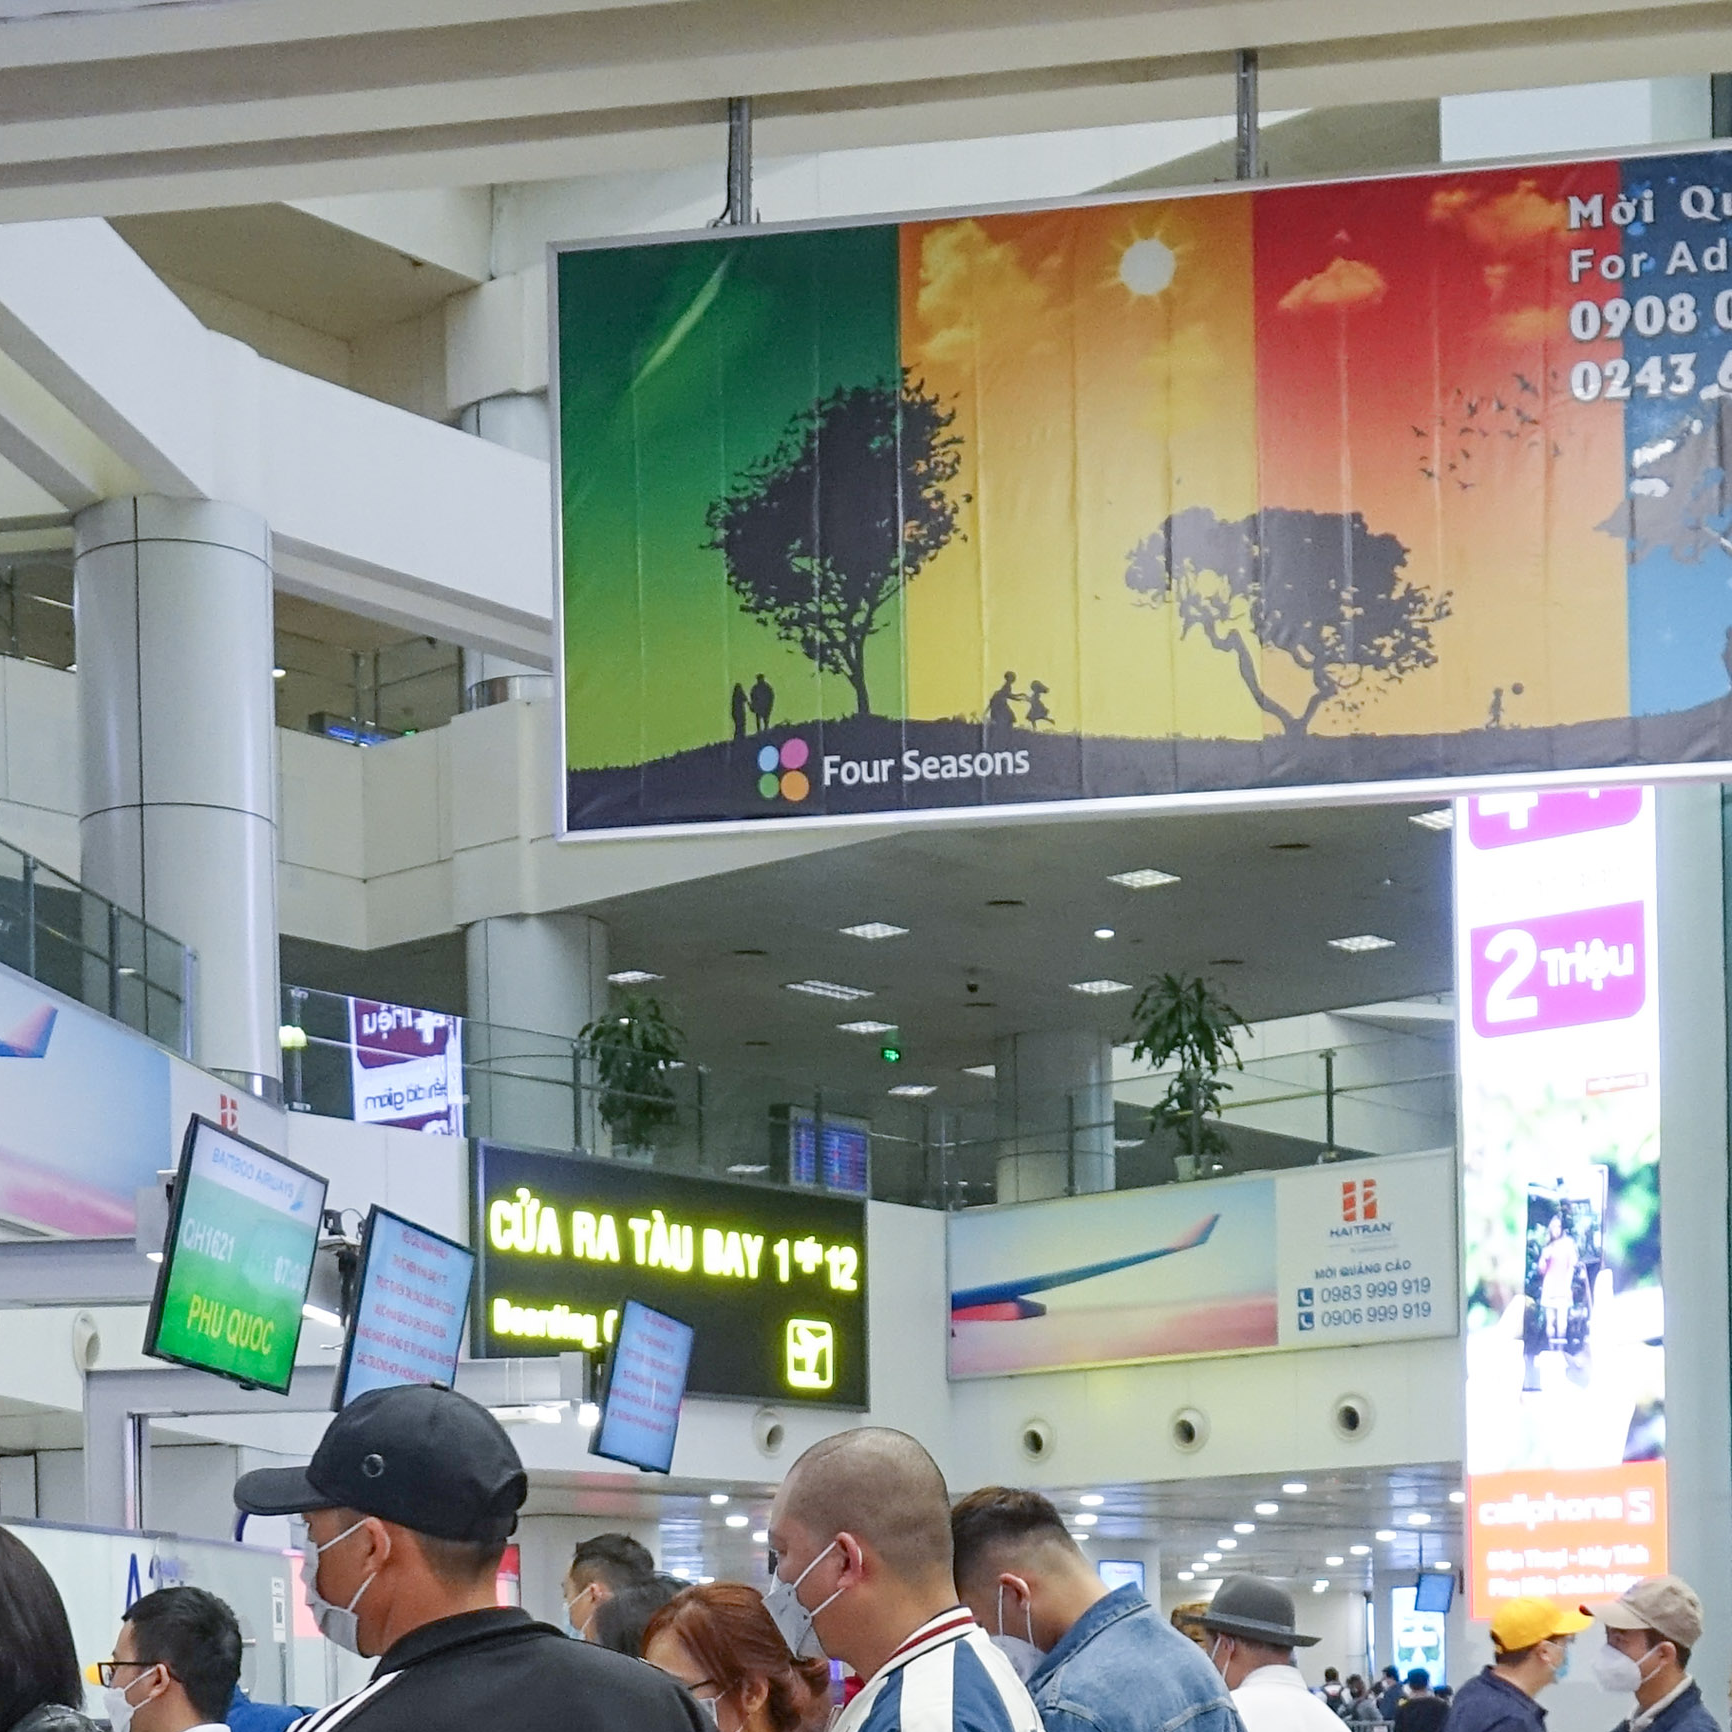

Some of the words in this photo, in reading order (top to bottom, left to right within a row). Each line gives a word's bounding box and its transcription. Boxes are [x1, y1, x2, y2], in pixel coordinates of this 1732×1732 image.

[1568, 189, 1655, 230] Mời
[1570, 248, 1648, 284] For
[1570, 292, 1698, 341] 0908
[1571, 352, 1697, 402] 0243
[823, 754, 895, 787] Four
[902, 749, 1030, 782] Seasons
[1484, 928, 1539, 1024] 2
[489, 1187, 562, 1256] CỬA
[572, 1210, 621, 1263] RA
[628, 1209, 694, 1272] TÀU
[702, 1227, 764, 1278] BAY
[773, 1238, 789, 1283] 1
[825, 1245, 859, 1292] 12
[1321, 1284, 1362, 1303] 0983
[1366, 1280, 1397, 1299] 999
[1401, 1277, 1431, 1295] 919
[1321, 1308, 1363, 1327] 0906
[1367, 1304, 1398, 1323] 999
[1403, 1301, 1432, 1319] 919
